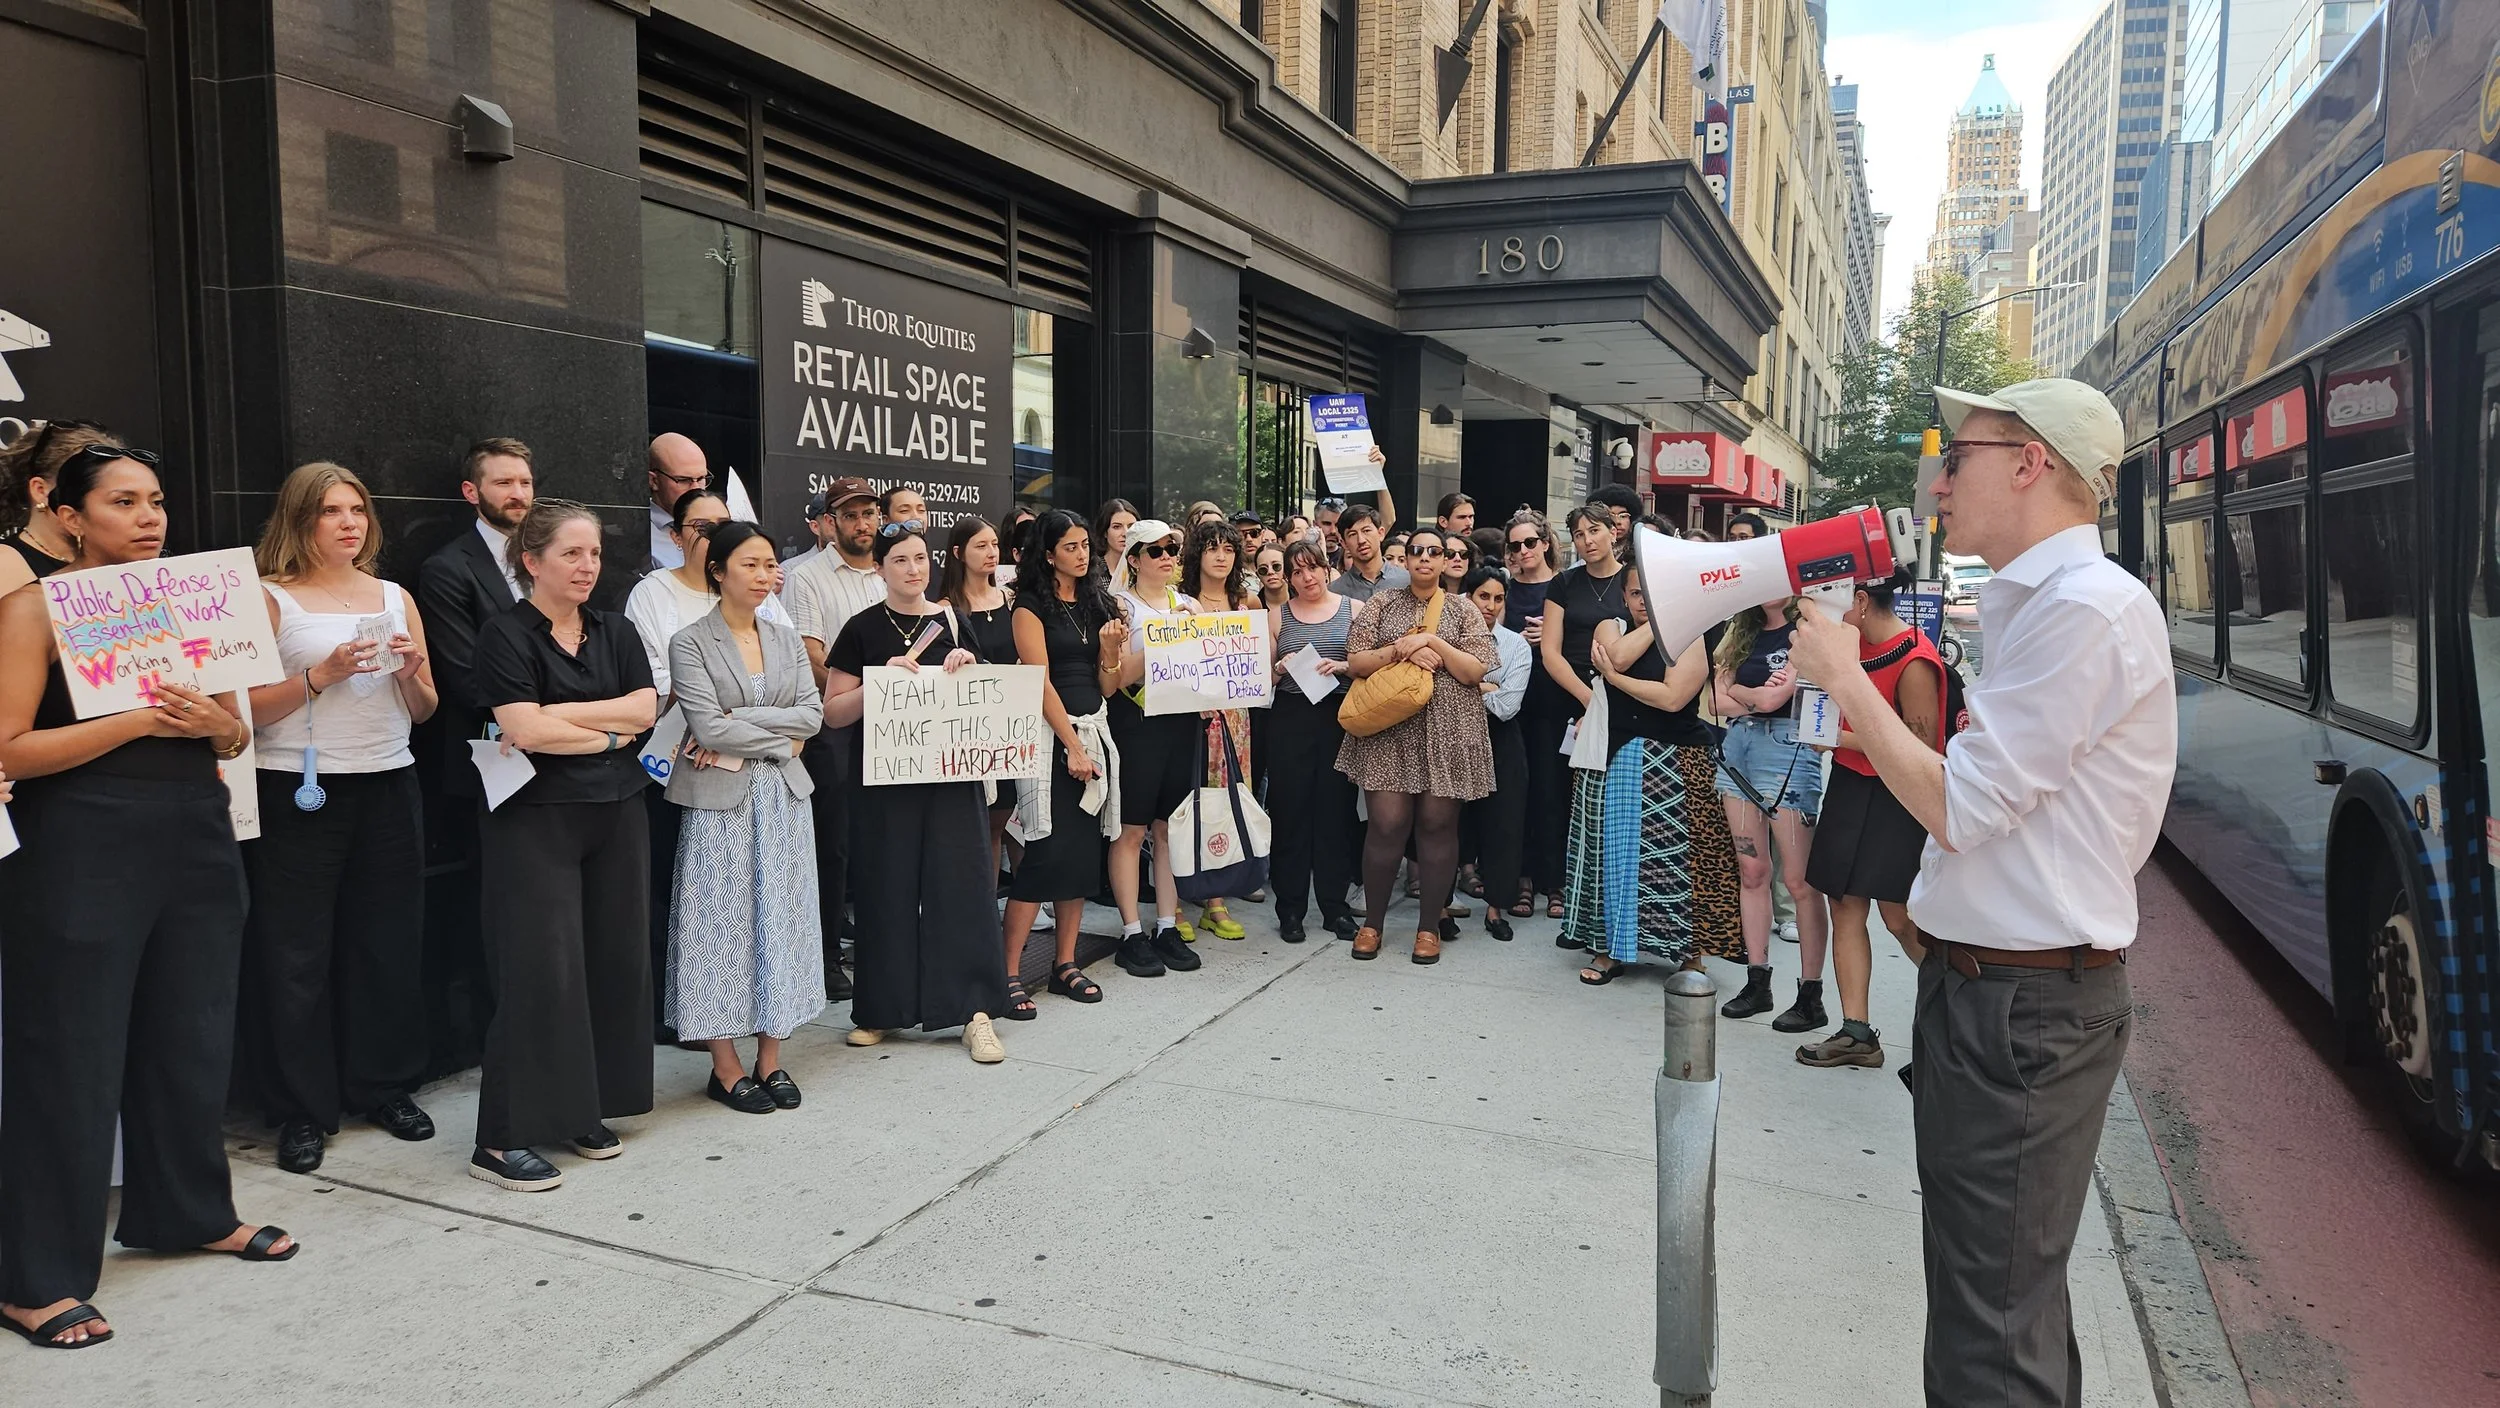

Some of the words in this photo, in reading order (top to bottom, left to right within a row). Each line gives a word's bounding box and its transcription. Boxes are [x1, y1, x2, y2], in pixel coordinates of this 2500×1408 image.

[1708, 88, 1750, 101] DLAS
[1478, 234, 1564, 275] 180
[2396, 252, 2413, 279] USB
[2435, 211, 2464, 269] 776
[841, 297, 901, 336] THOR
[905, 314, 976, 352] EQUITIES
[794, 340, 899, 398] RETAIL
[905, 363, 986, 412] SPACE
[1318, 407, 1341, 416] LOCAL
[1342, 406, 1359, 415] 2325
[1329, 398, 1345, 406] UAW
[796, 395, 986, 466] AVAILABLE
[49, 579, 124, 622] Public
[120, 567, 217, 606] Defense
[216, 564, 241, 590] is
[1700, 564, 1741, 586] PYLE
[65, 606, 174, 651] Essential
[1231, 636, 1260, 653] NOT
[77, 654, 173, 690] Working
[179, 637, 258, 669] Fucking
[1151, 655, 1200, 692] Belong
[1200, 659, 1225, 677] In
[1226, 654, 1263, 677] Public
[137, 671, 200, 705] Hrd
[874, 679, 945, 713] YEAH,
[956, 678, 1004, 707] LET'S
[1227, 680, 1265, 699] Defense
[874, 719, 932, 750] MAKE
[942, 715, 992, 744] THIS
[1000, 714, 1038, 742] JOB
[874, 755, 924, 781] EVEN
[941, 743, 1036, 777] HARDER!!
